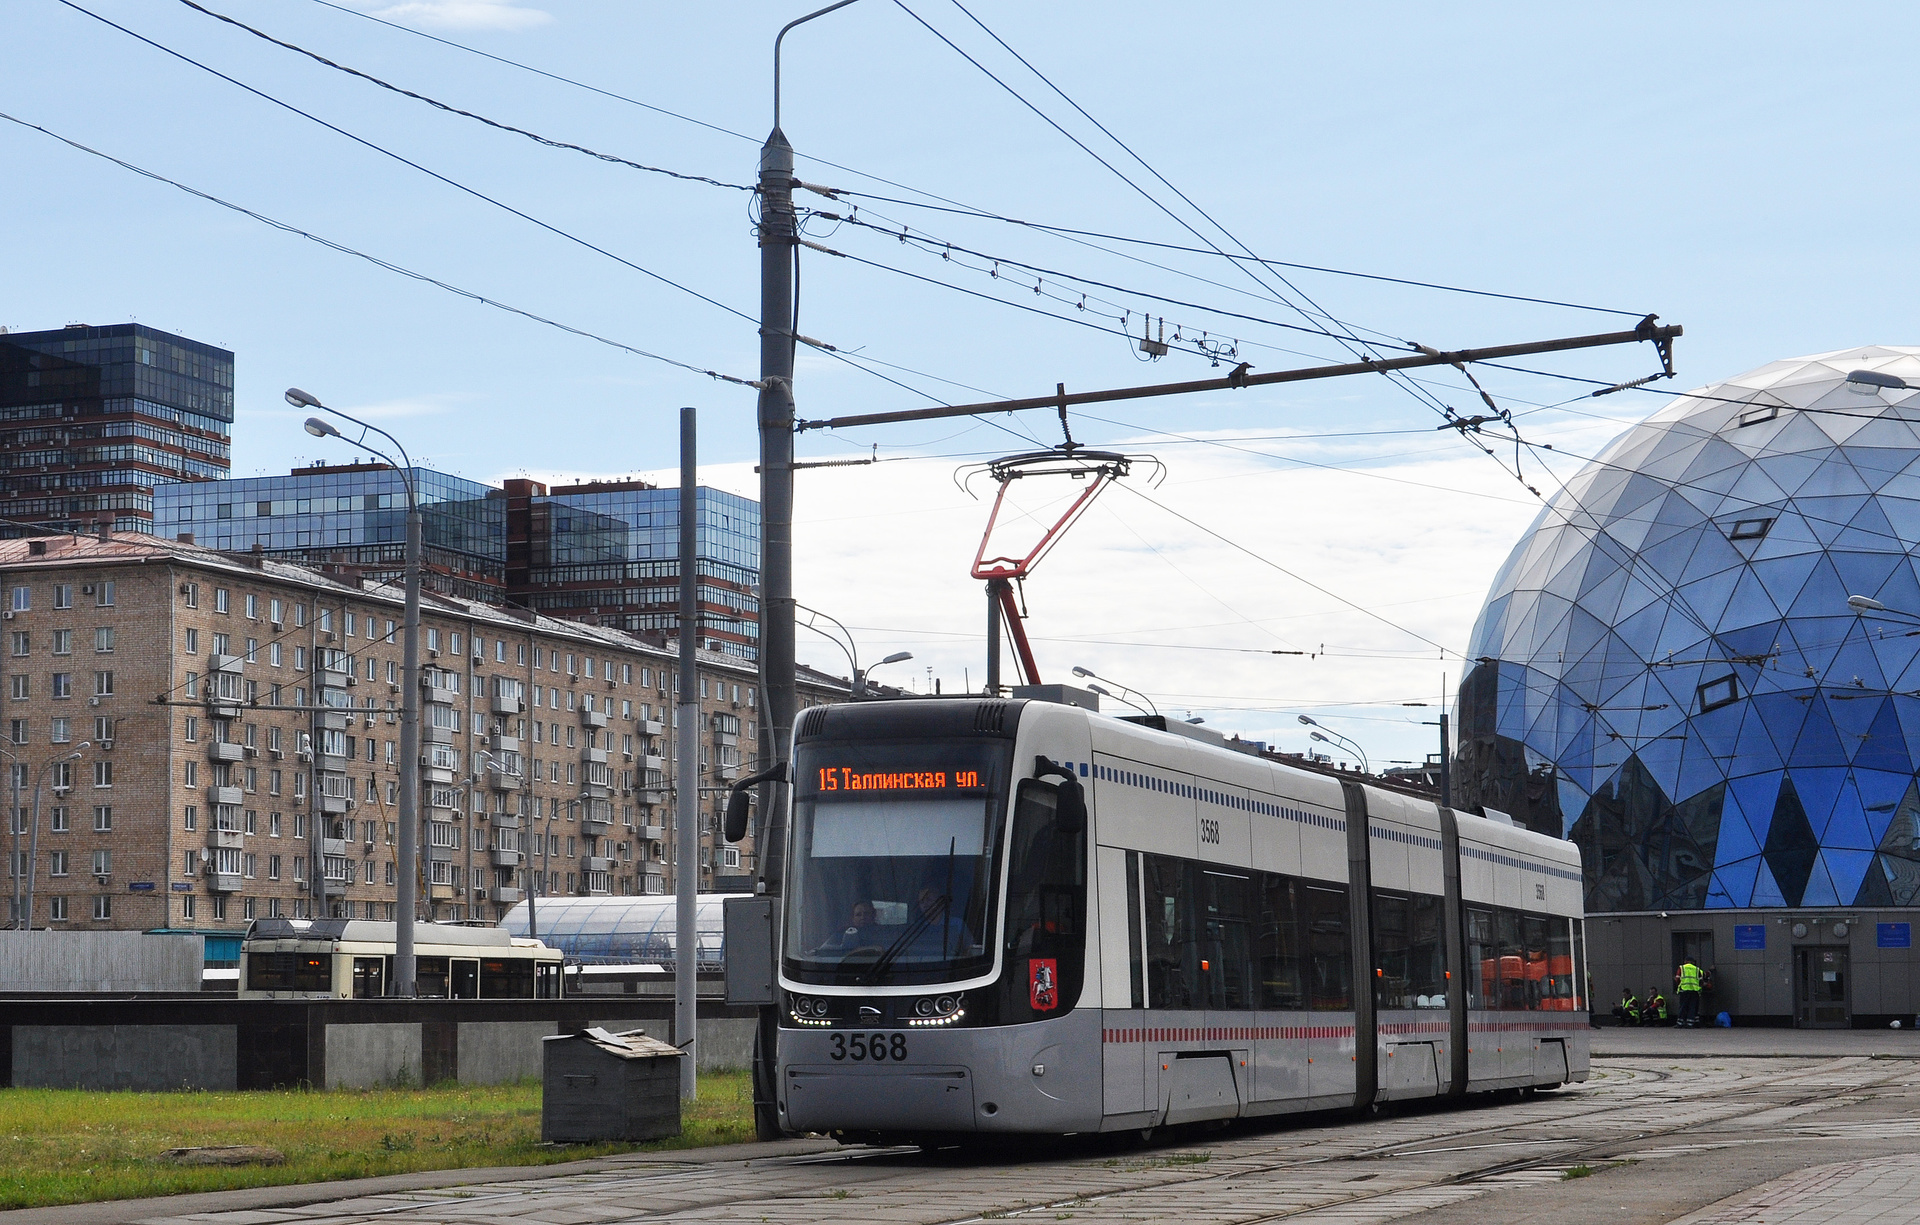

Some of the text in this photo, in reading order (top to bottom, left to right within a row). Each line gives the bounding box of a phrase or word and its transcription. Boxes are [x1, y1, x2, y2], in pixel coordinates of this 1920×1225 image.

[819, 767, 986, 791] 15 Таллинская ул.
[1200, 818, 1220, 845] 3568
[829, 1032, 908, 1062] 3568
